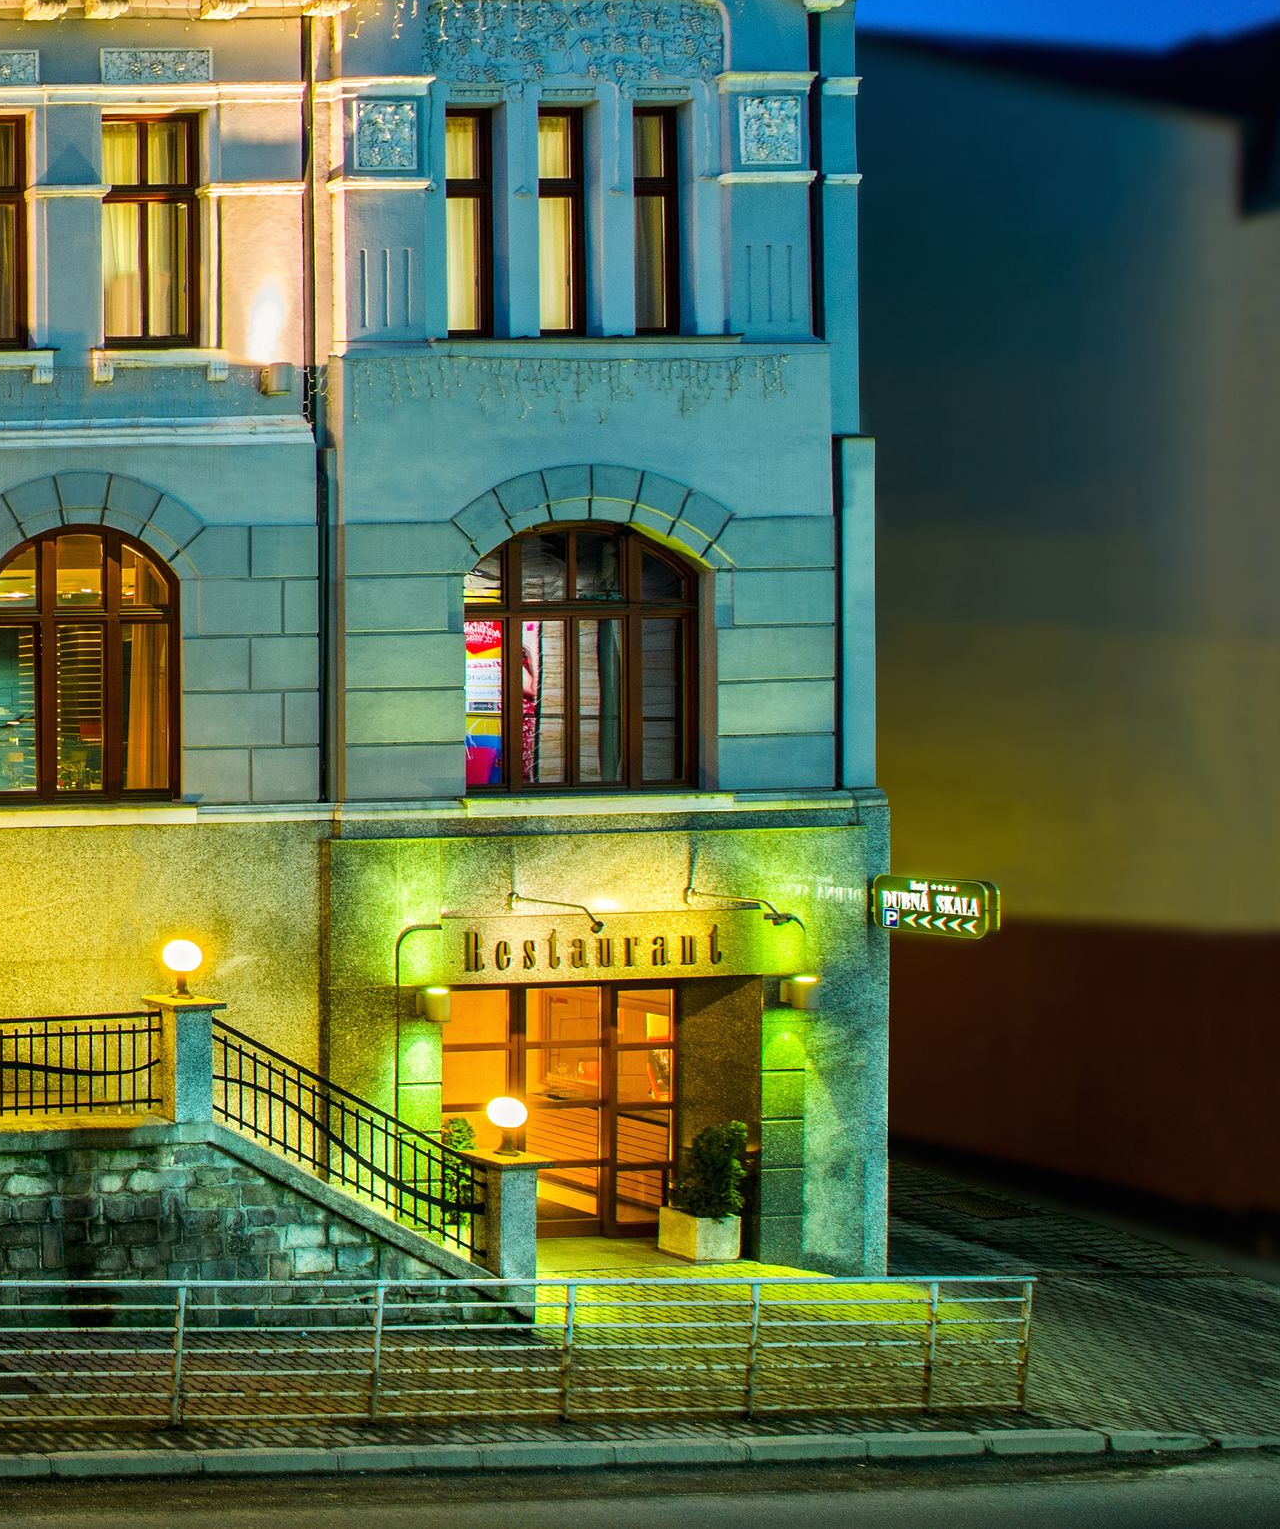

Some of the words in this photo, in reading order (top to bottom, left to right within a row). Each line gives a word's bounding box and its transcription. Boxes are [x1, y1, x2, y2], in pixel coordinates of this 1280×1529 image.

[882, 890, 930, 912] DUBNÁ
[935, 895, 980, 917] SKALA
[885, 910, 898, 926] P
[464, 924, 722, 972] Restaurant
